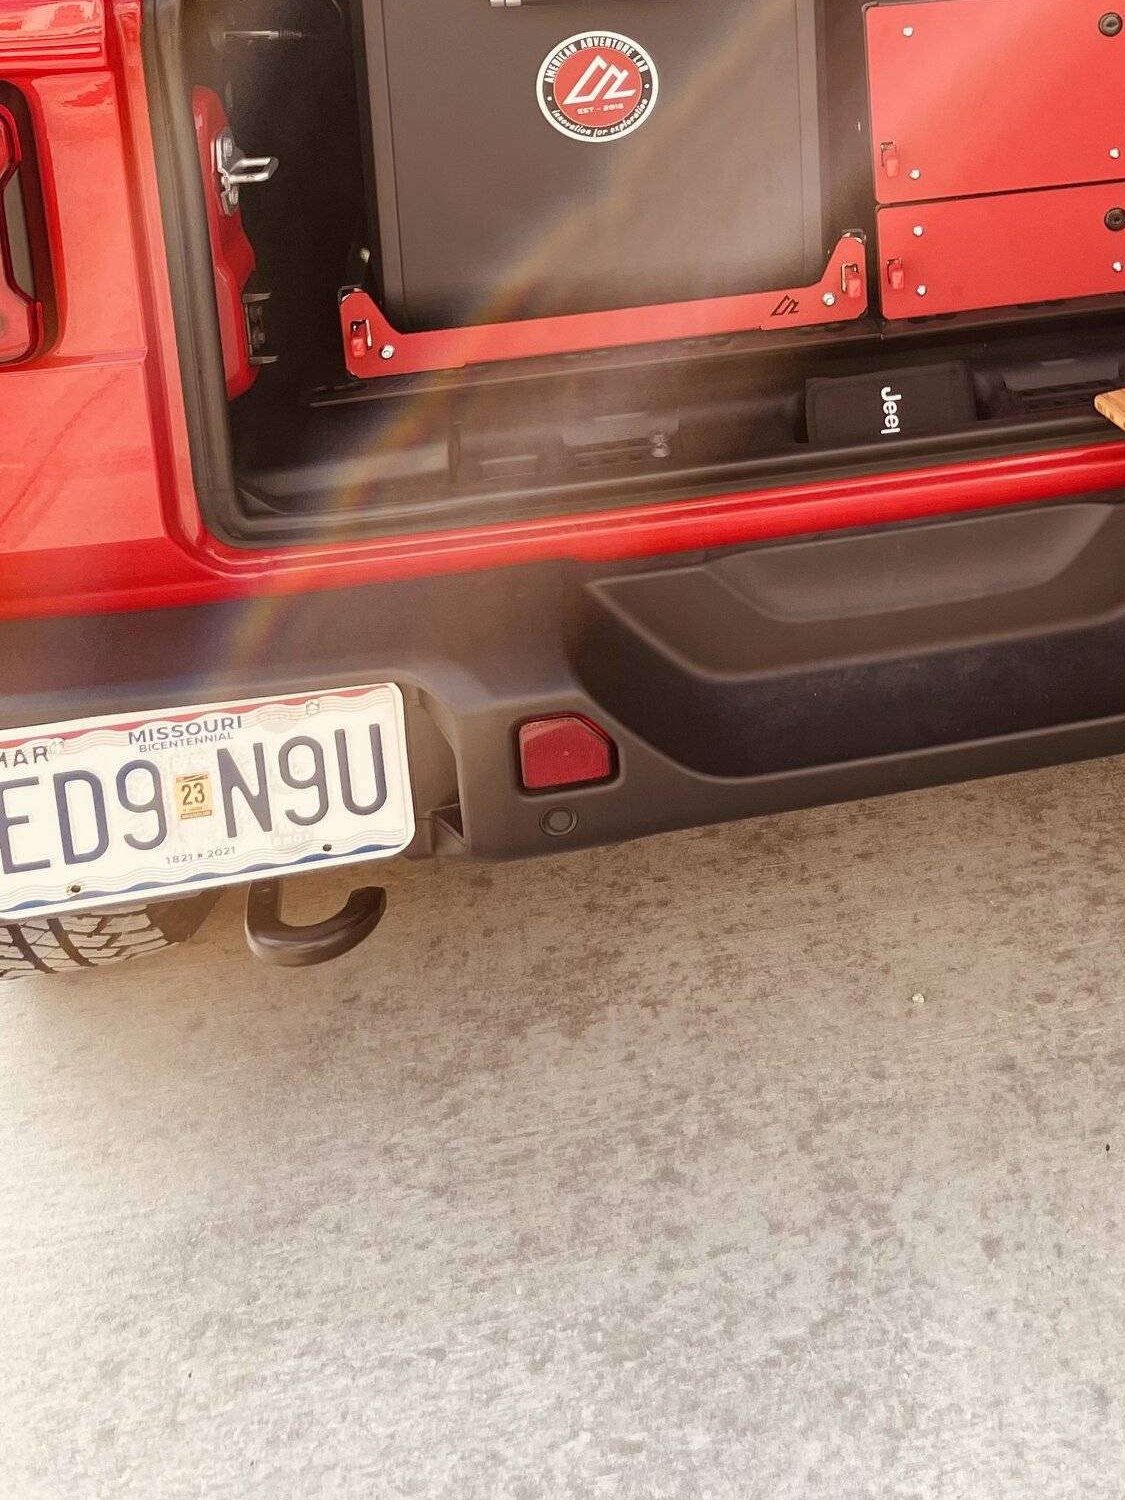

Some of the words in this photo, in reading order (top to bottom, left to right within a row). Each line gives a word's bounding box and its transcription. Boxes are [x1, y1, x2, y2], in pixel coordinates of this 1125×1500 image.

[544, 43, 578, 83] AMERICAN
[580, 37, 634, 56] ADVENTURE
[634, 54, 649, 73] LAB
[610, 99, 648, 133] exploration
[128, 716, 242, 745] MISSOURI
[139, 732, 234, 753] BICENTENNIAL
[0, 759, 168, 875] ED9
[217, 723, 388, 839] N9U
[181, 782, 206, 806] 23
[166, 852, 193, 865] 1821
[207, 846, 236, 858] 2021
